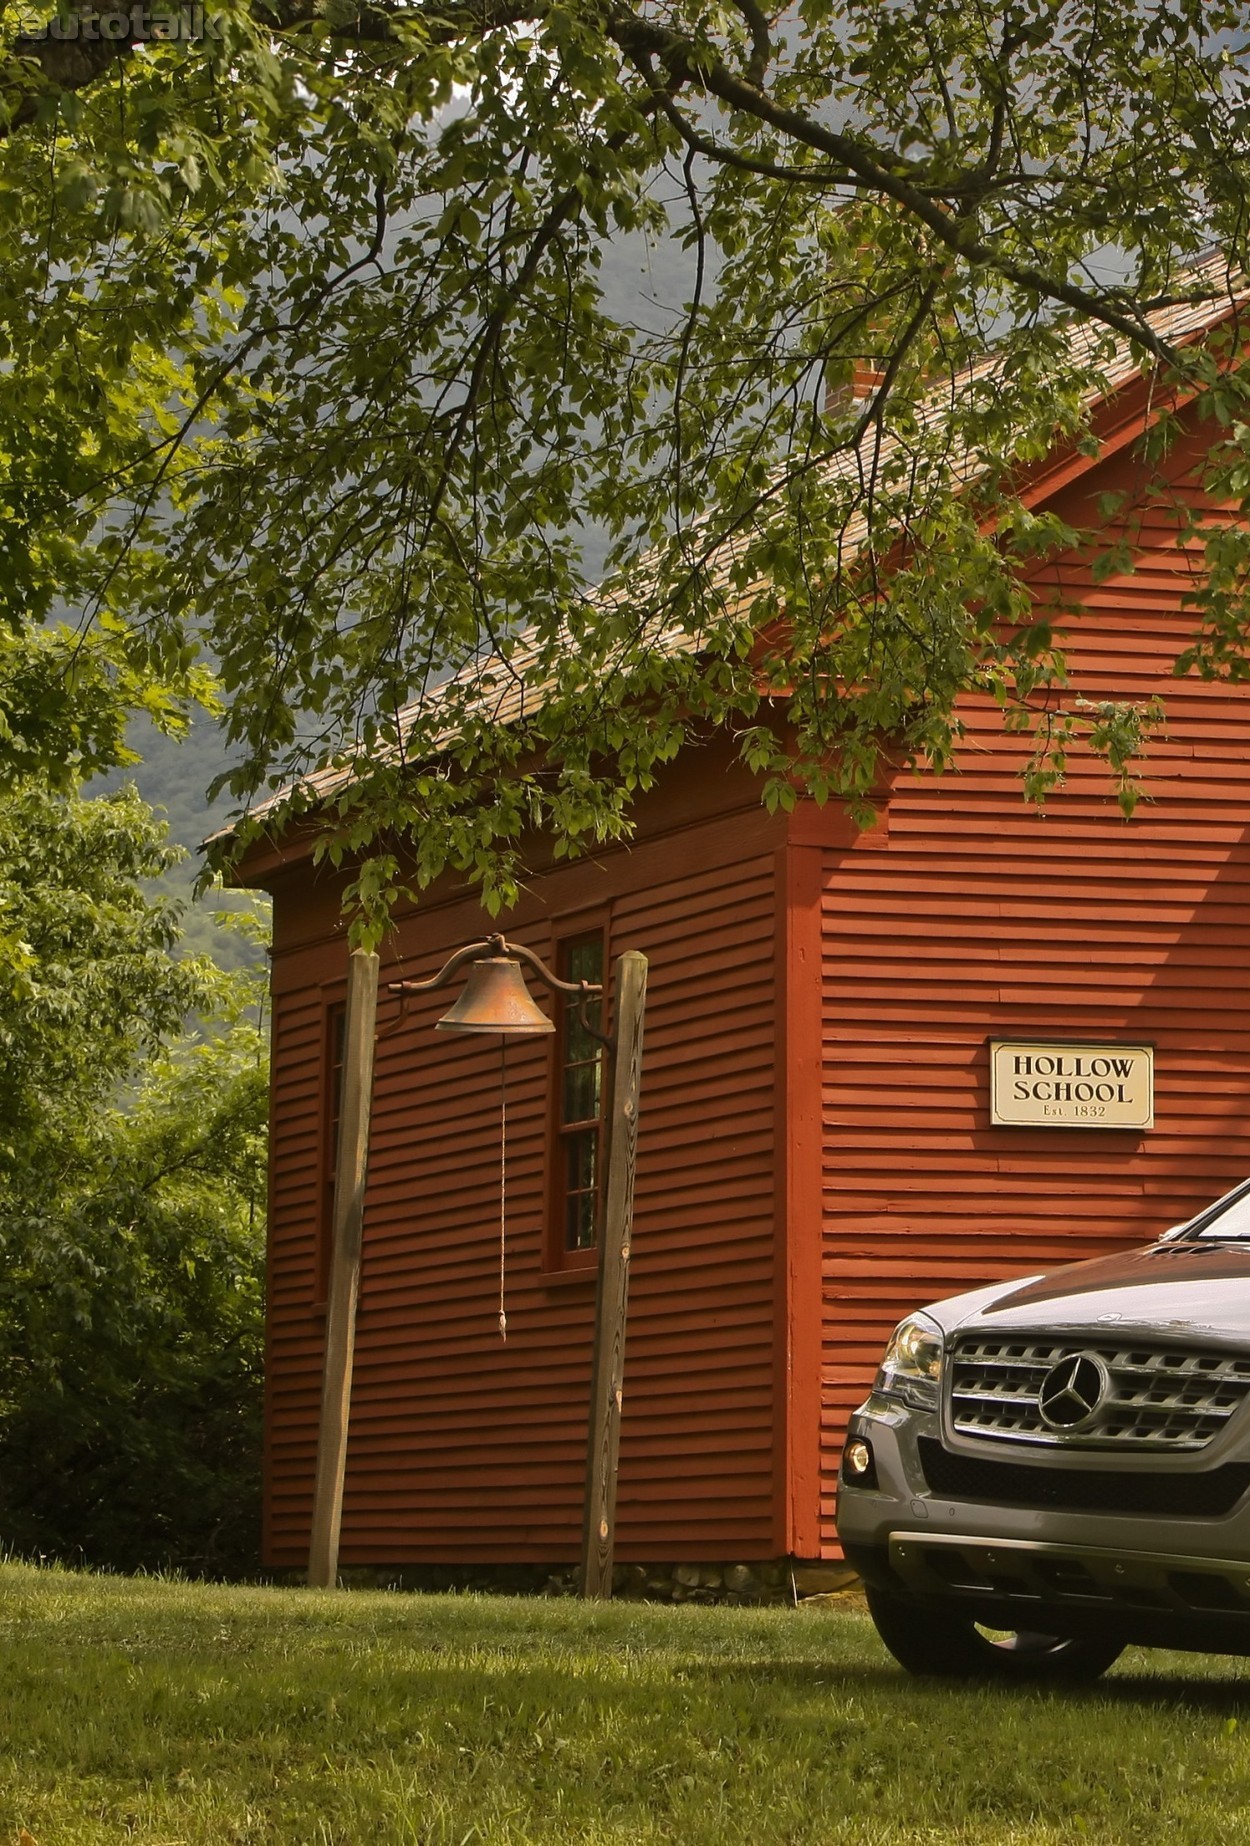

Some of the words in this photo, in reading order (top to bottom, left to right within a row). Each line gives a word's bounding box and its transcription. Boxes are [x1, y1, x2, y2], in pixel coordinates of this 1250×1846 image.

[1013, 1055, 1135, 1079] HOLLOW
[1013, 1081, 1133, 1103] SCHOOL
[1043, 1105, 1067, 1117] Est.
[1074, 1106, 1106, 1117] 1832
